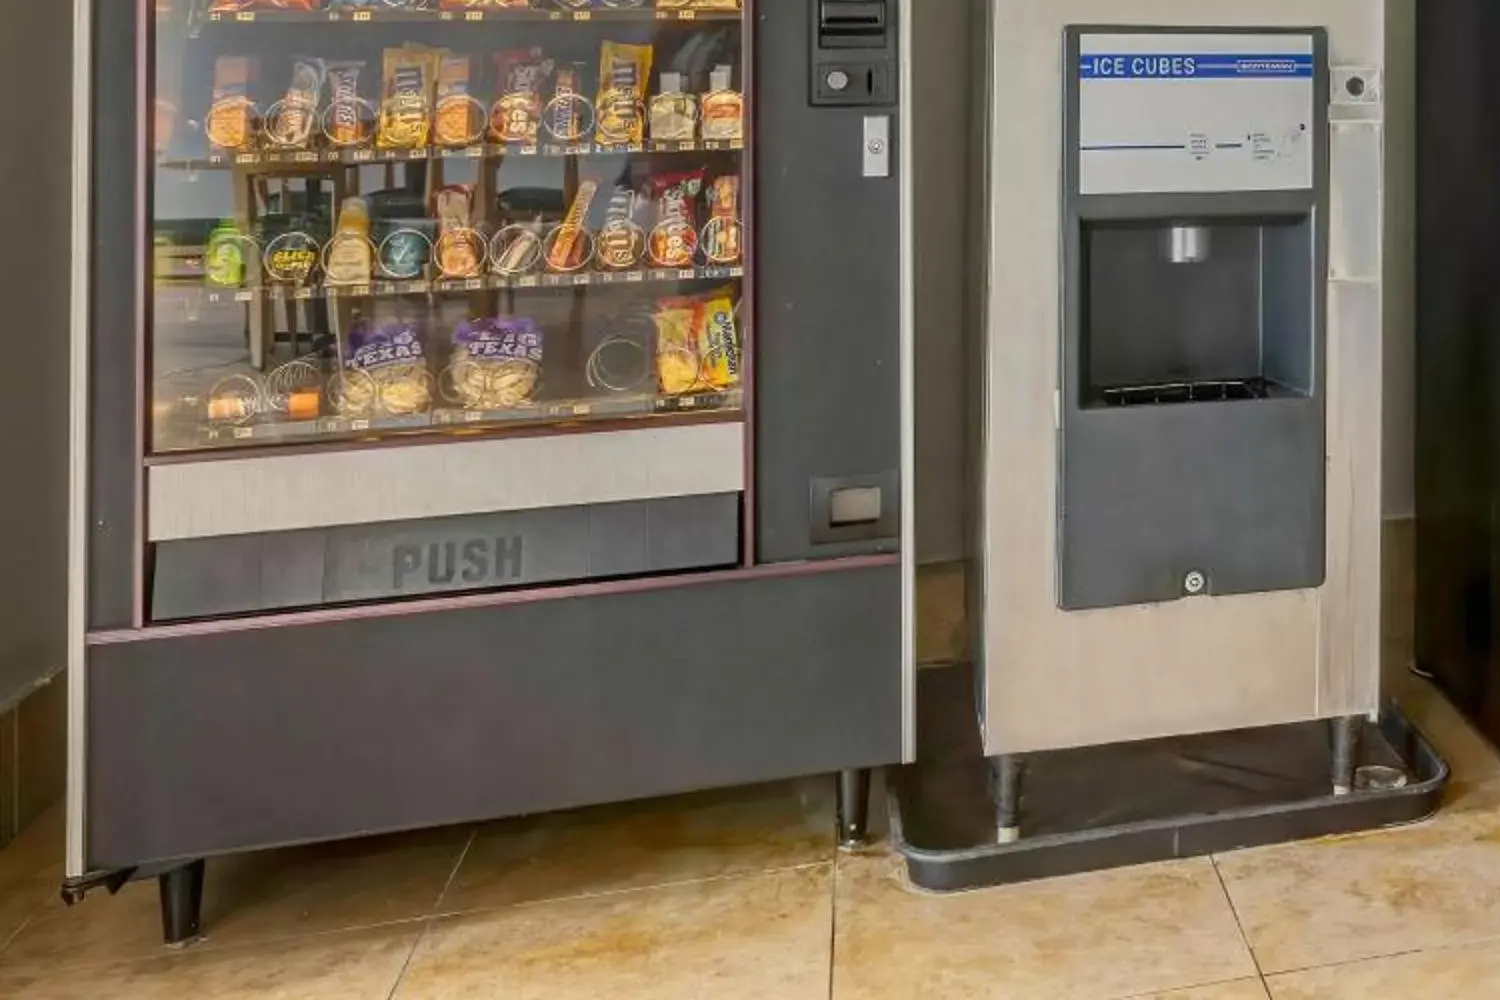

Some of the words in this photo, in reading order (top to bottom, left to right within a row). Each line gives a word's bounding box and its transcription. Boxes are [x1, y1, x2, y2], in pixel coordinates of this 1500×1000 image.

[1092, 57, 1125, 76] ICE
[1131, 56, 1196, 76] CUBES
[393, 535, 522, 589] PUSH
